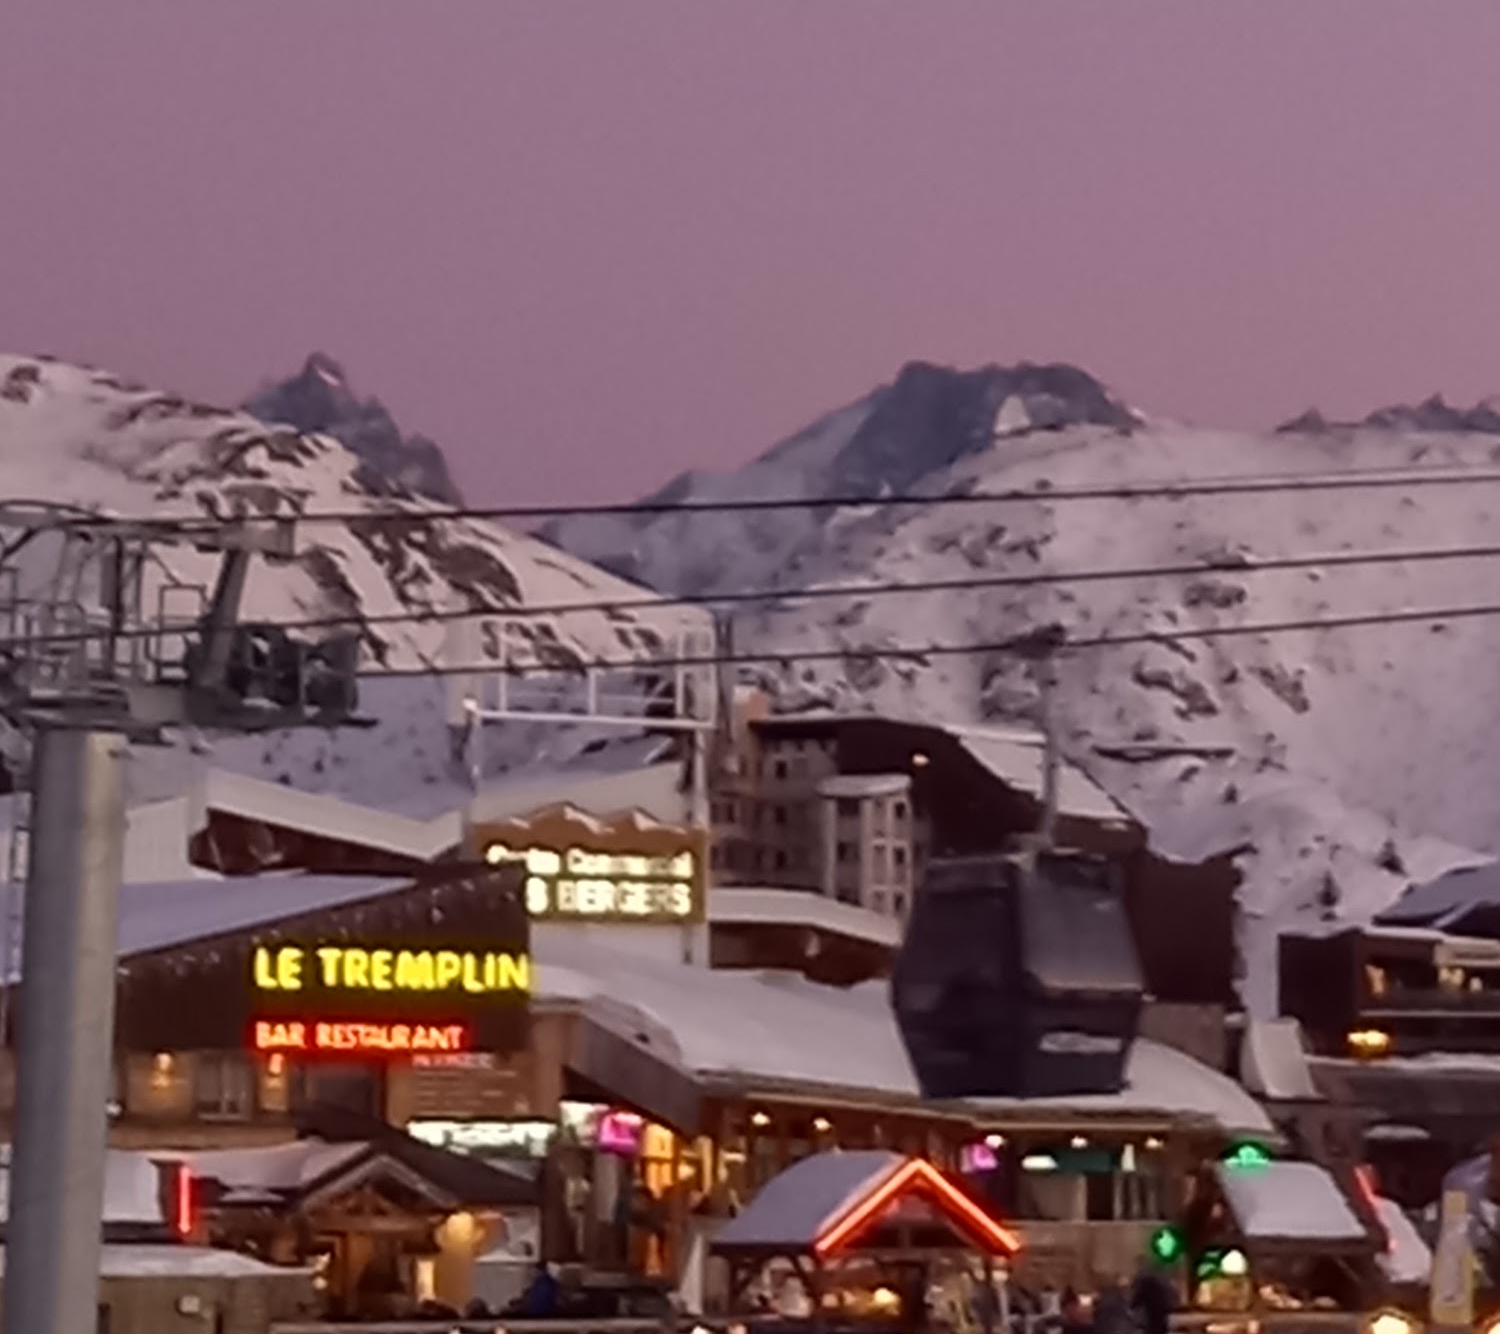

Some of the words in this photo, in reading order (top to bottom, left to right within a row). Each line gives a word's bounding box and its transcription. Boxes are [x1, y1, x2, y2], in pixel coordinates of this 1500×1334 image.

[556, 879, 692, 916] BERGERS
[254, 946, 304, 990] LE
[315, 946, 530, 993] TREMPLIN
[255, 1021, 306, 1049] BAR
[315, 1022, 464, 1050] RESTAURANT
